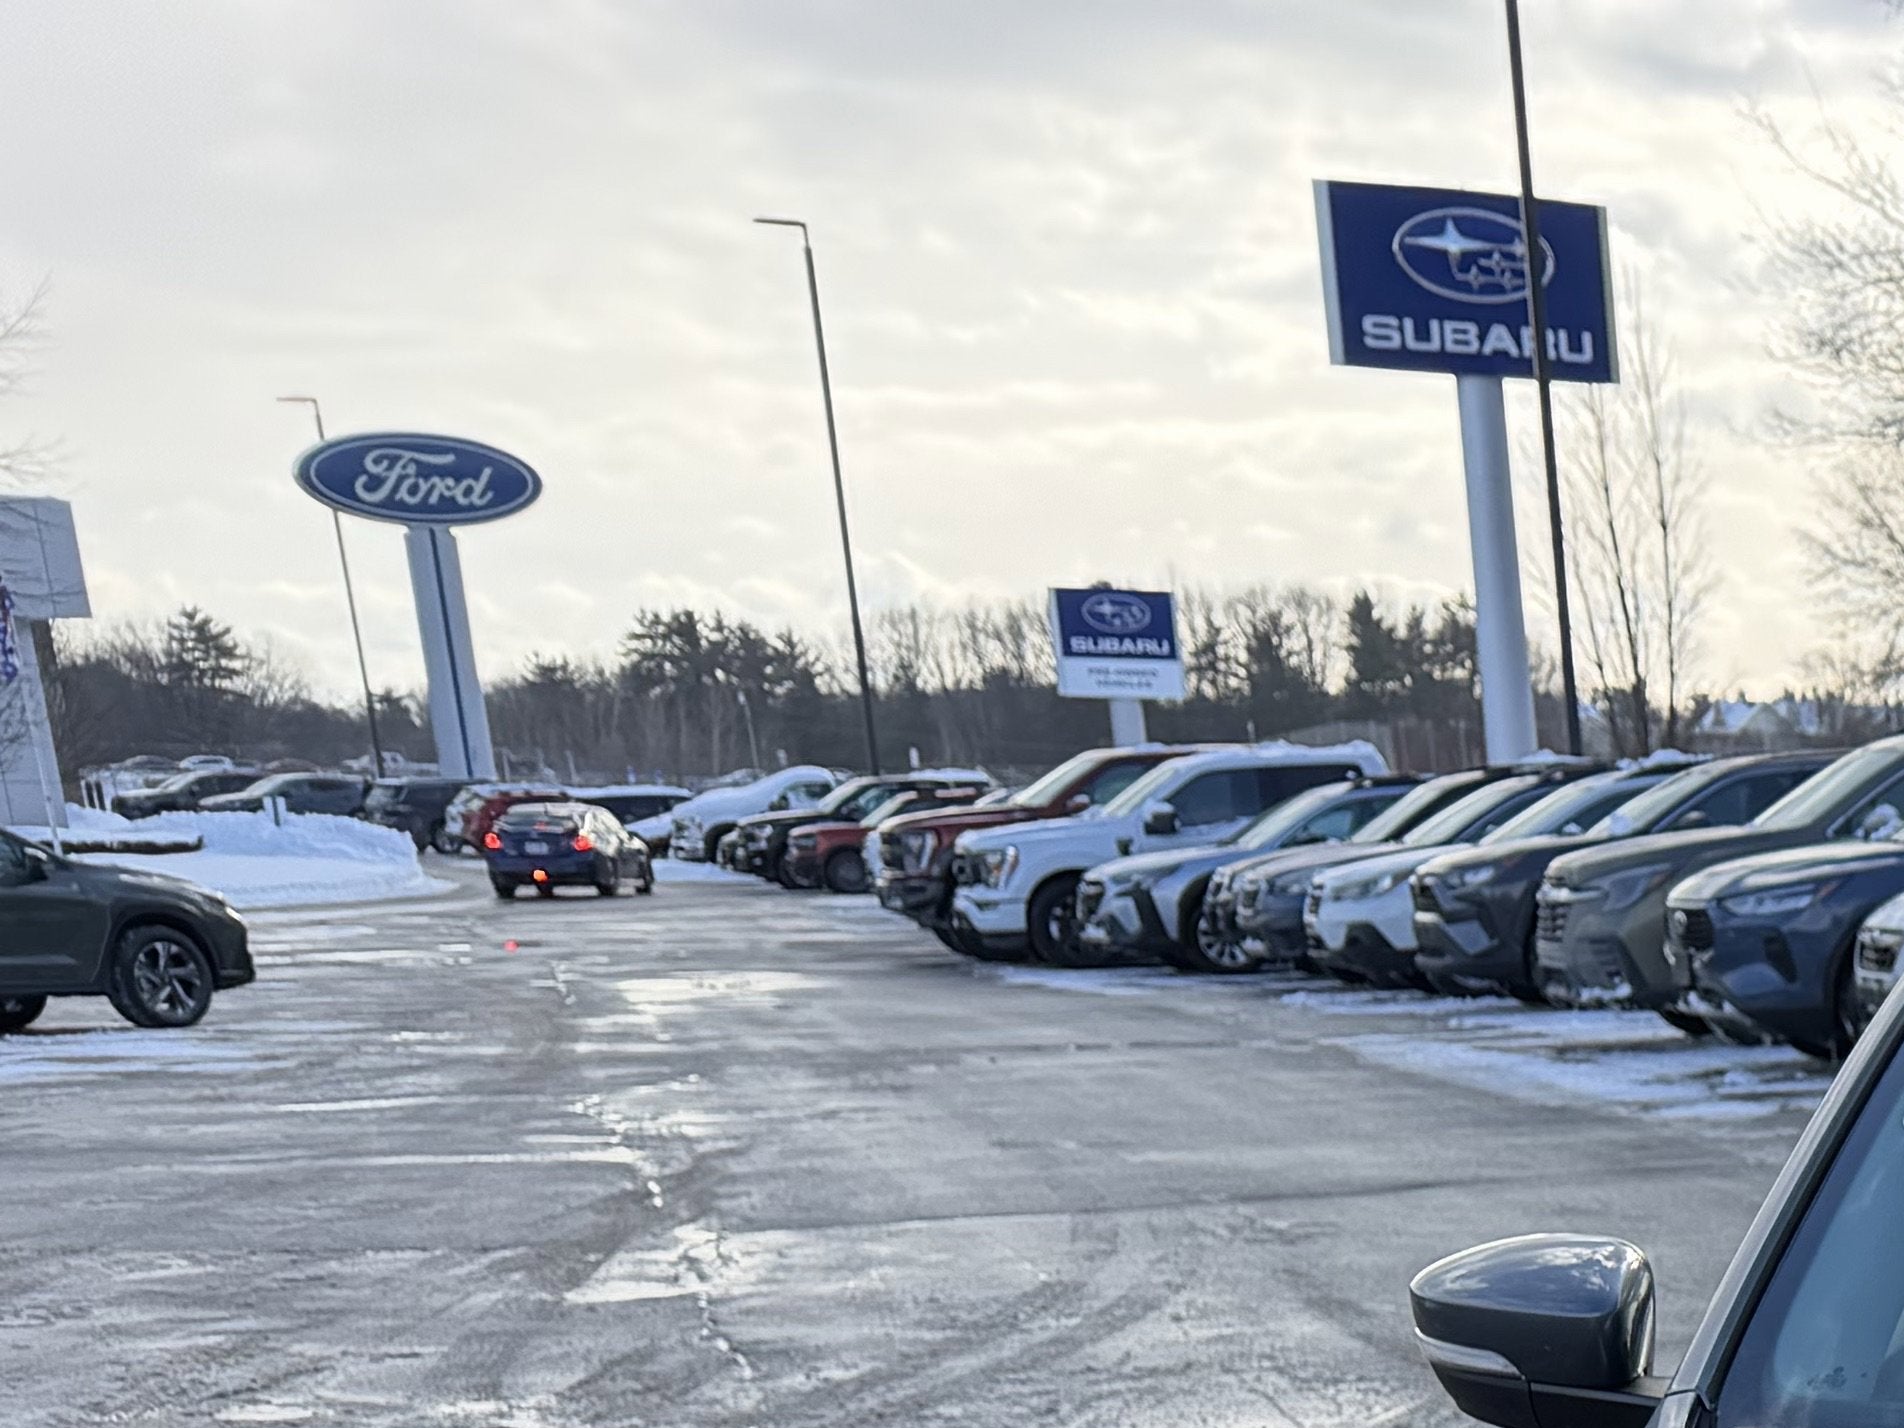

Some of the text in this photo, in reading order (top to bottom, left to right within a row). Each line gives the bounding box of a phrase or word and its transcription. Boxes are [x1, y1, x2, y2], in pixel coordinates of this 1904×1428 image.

[1361, 314, 1594, 365] SUBARU
[353, 447, 495, 507] Ford
[1069, 635, 1171, 657] SUBARU
